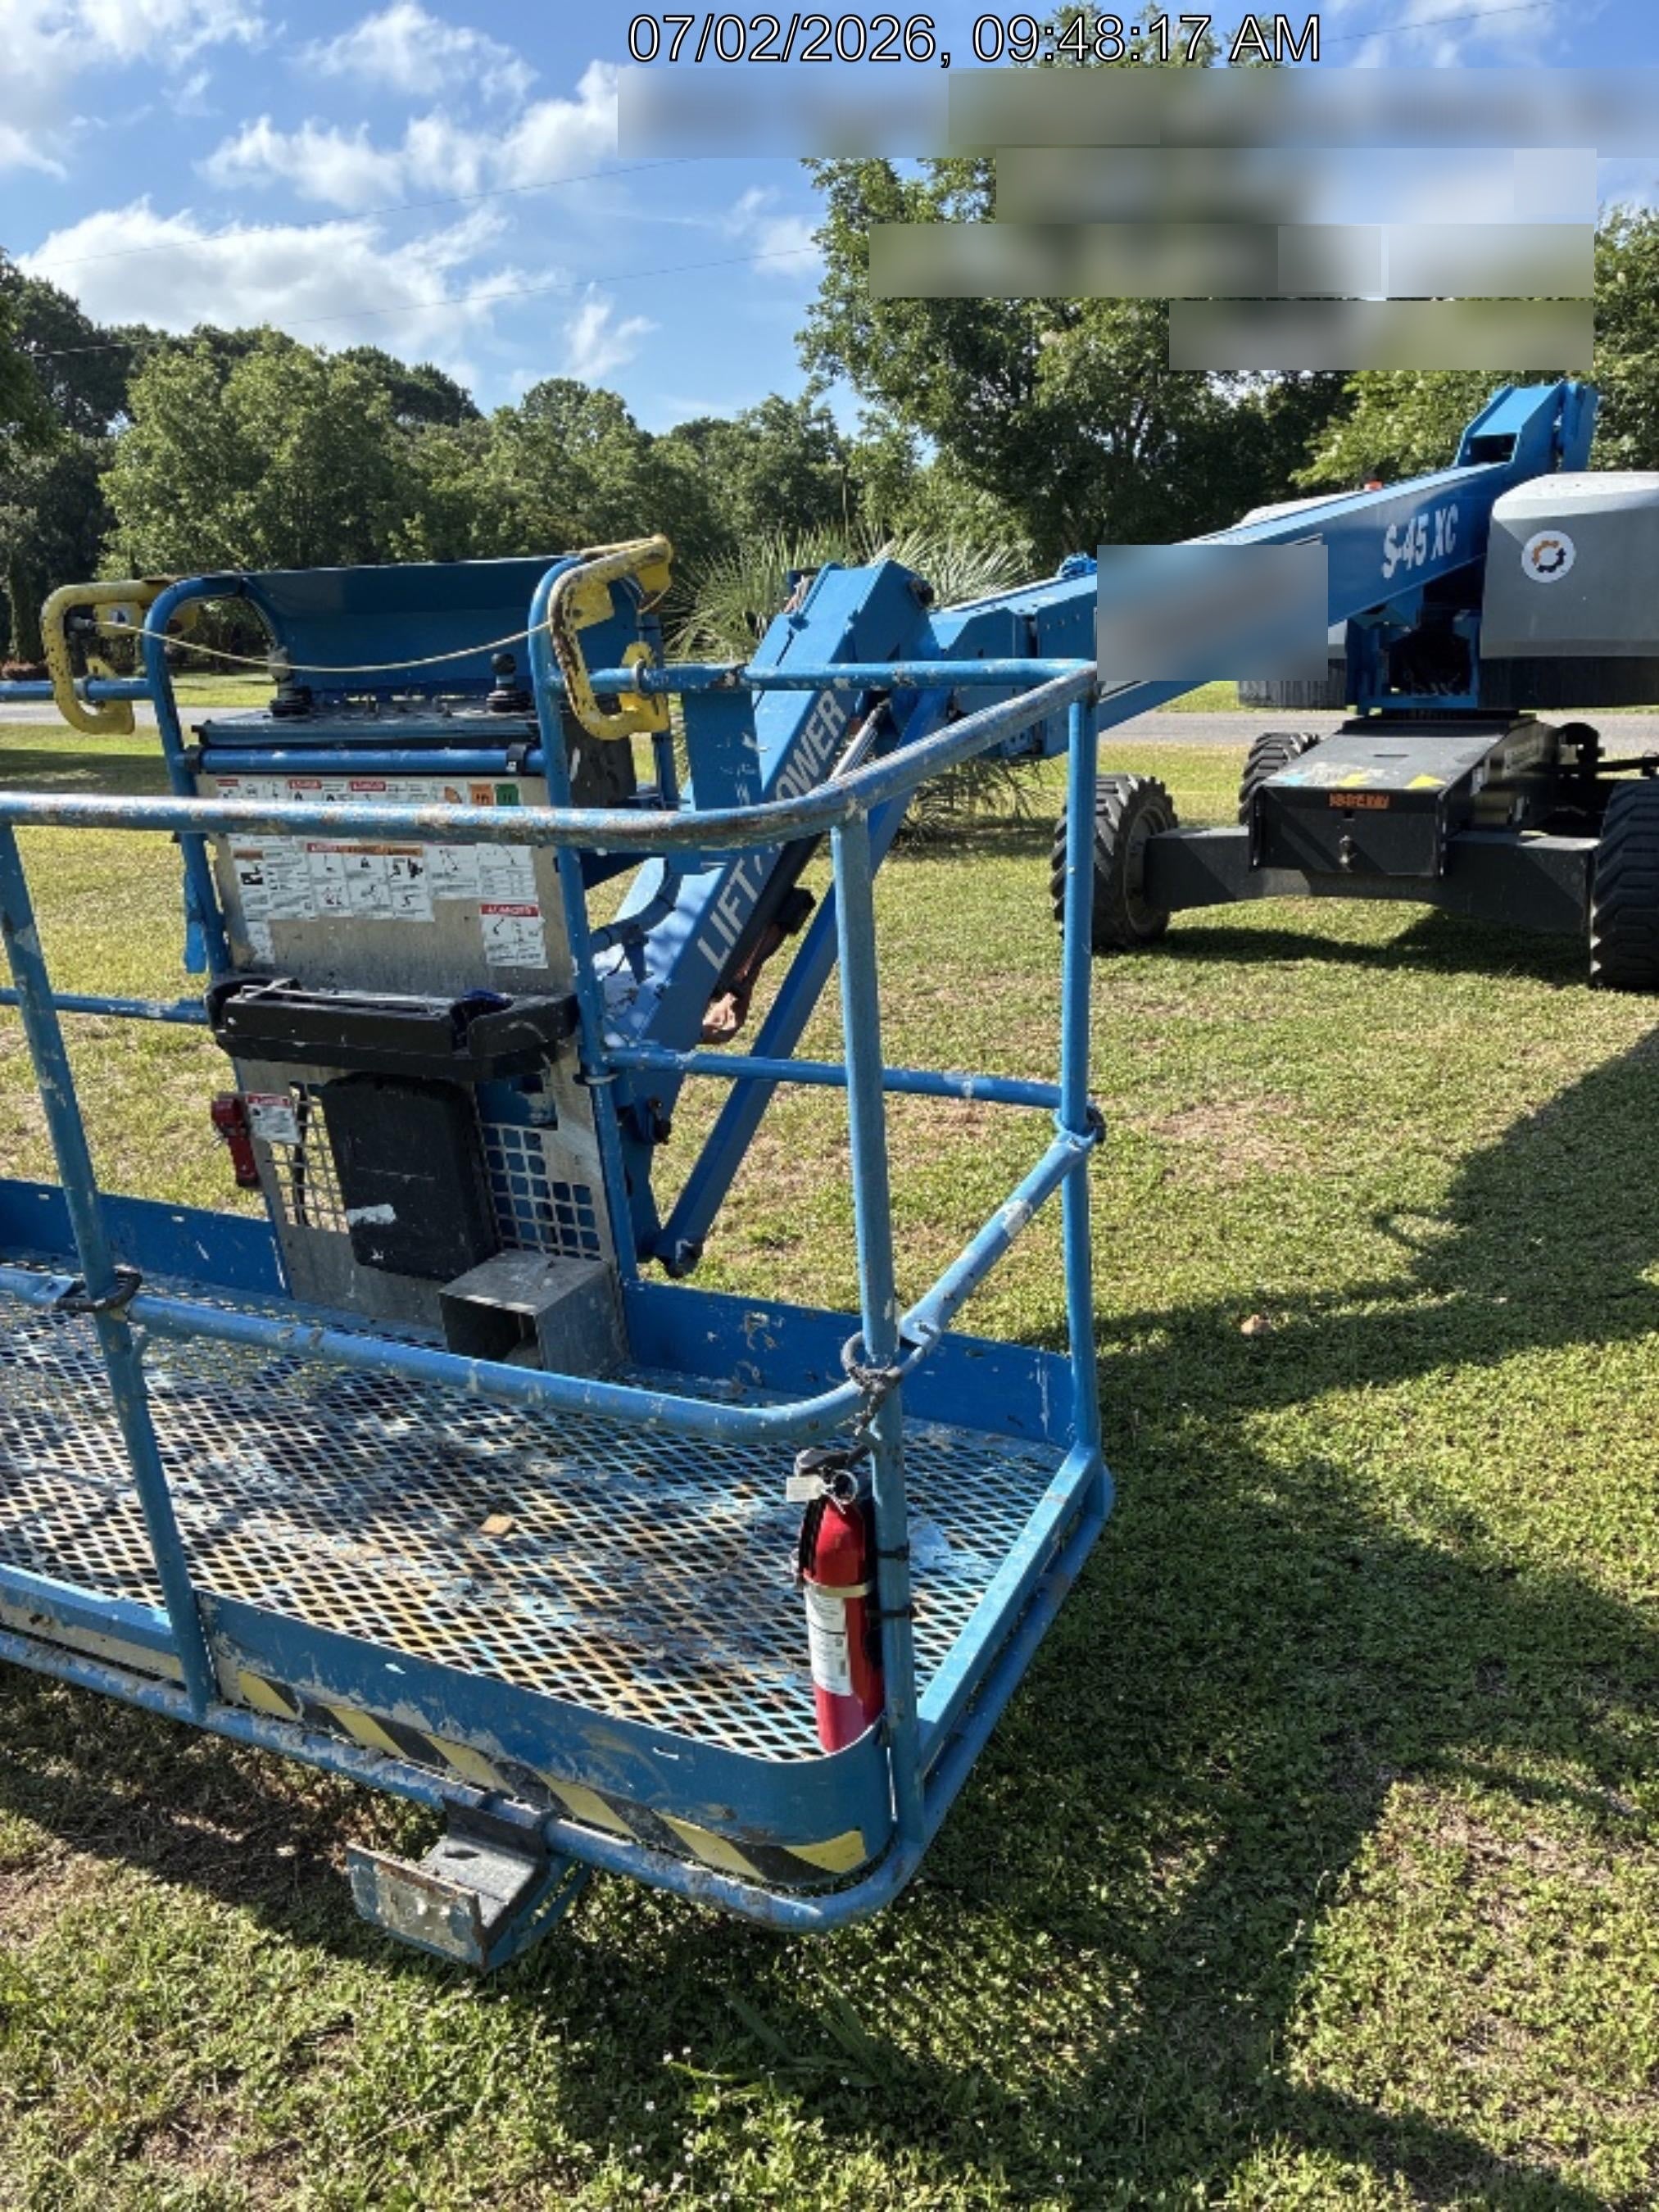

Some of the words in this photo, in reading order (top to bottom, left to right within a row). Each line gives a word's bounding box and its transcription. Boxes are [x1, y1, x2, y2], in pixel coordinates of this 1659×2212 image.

[1381, 512, 1429, 579] S-45
[1430, 503, 1458, 561] XC
[697, 857, 759, 973] LIFT
